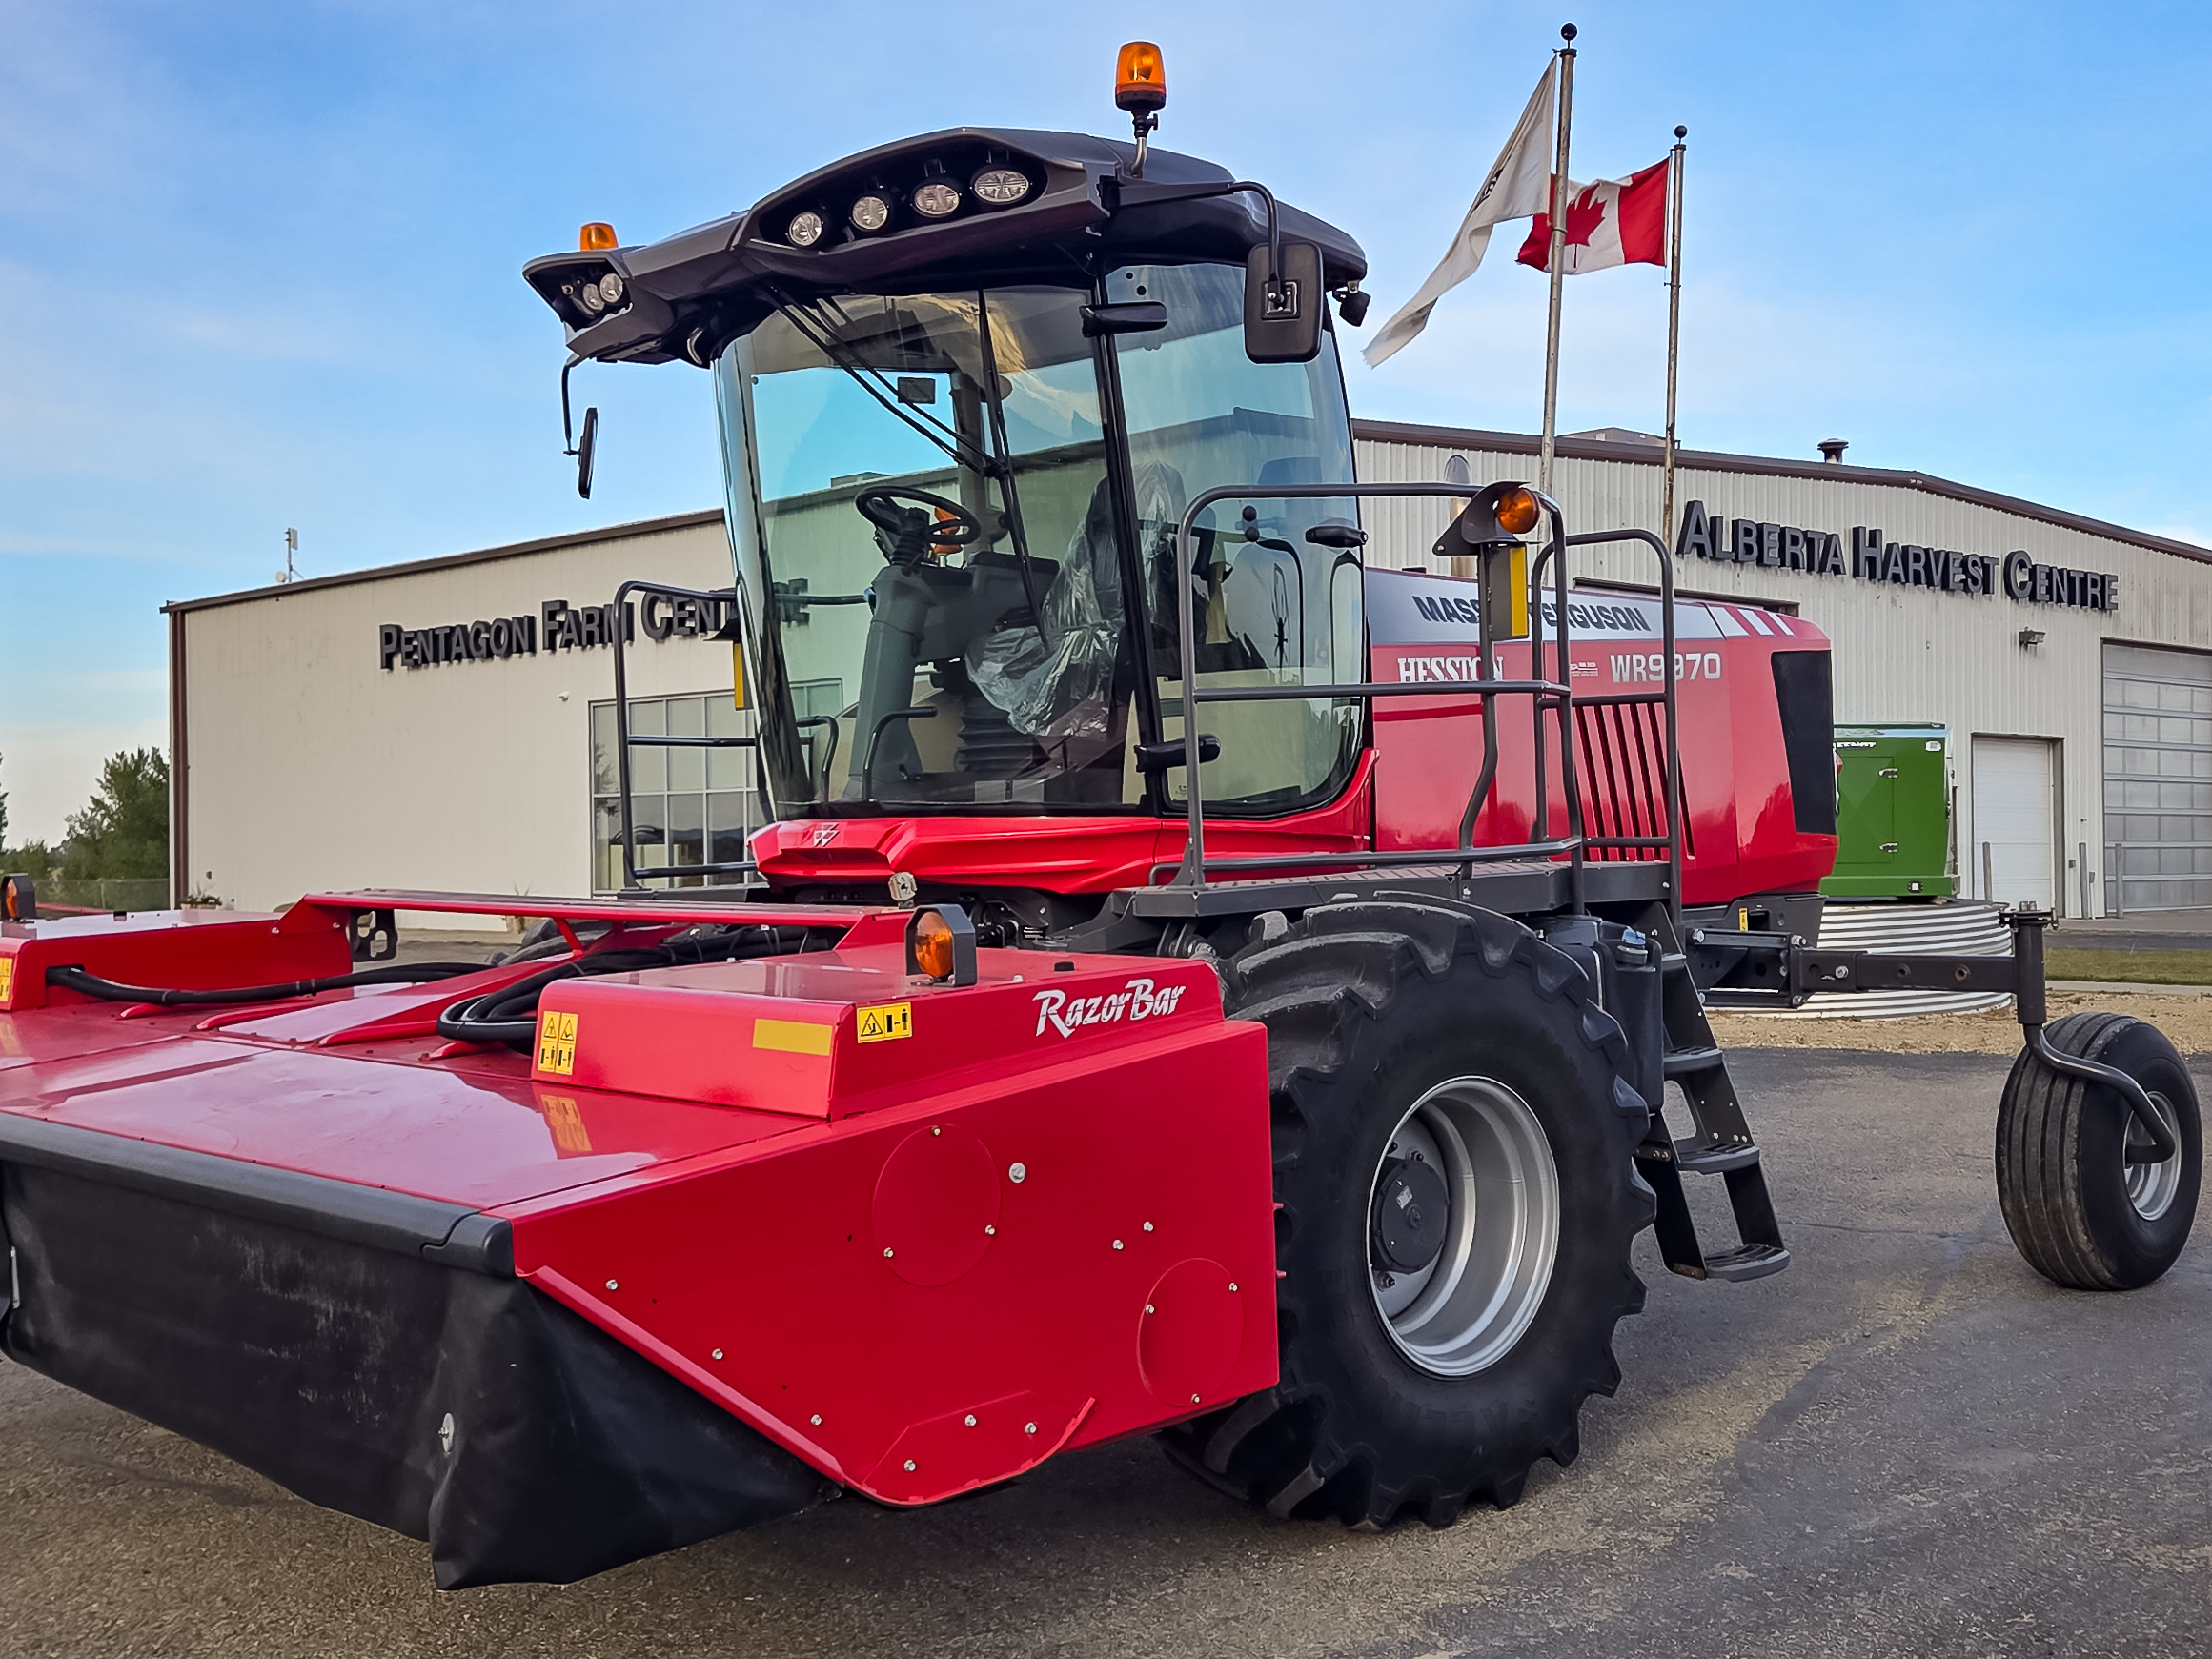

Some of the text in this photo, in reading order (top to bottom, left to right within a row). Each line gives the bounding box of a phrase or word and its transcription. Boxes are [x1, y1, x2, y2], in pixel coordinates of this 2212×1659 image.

[1676, 500, 2119, 611] ALBERTA HARVEST CENTRE
[379, 615, 537, 669] PENTAGON
[542, 600, 634, 650] FARM
[1032, 978, 1187, 1039] RazorBar
